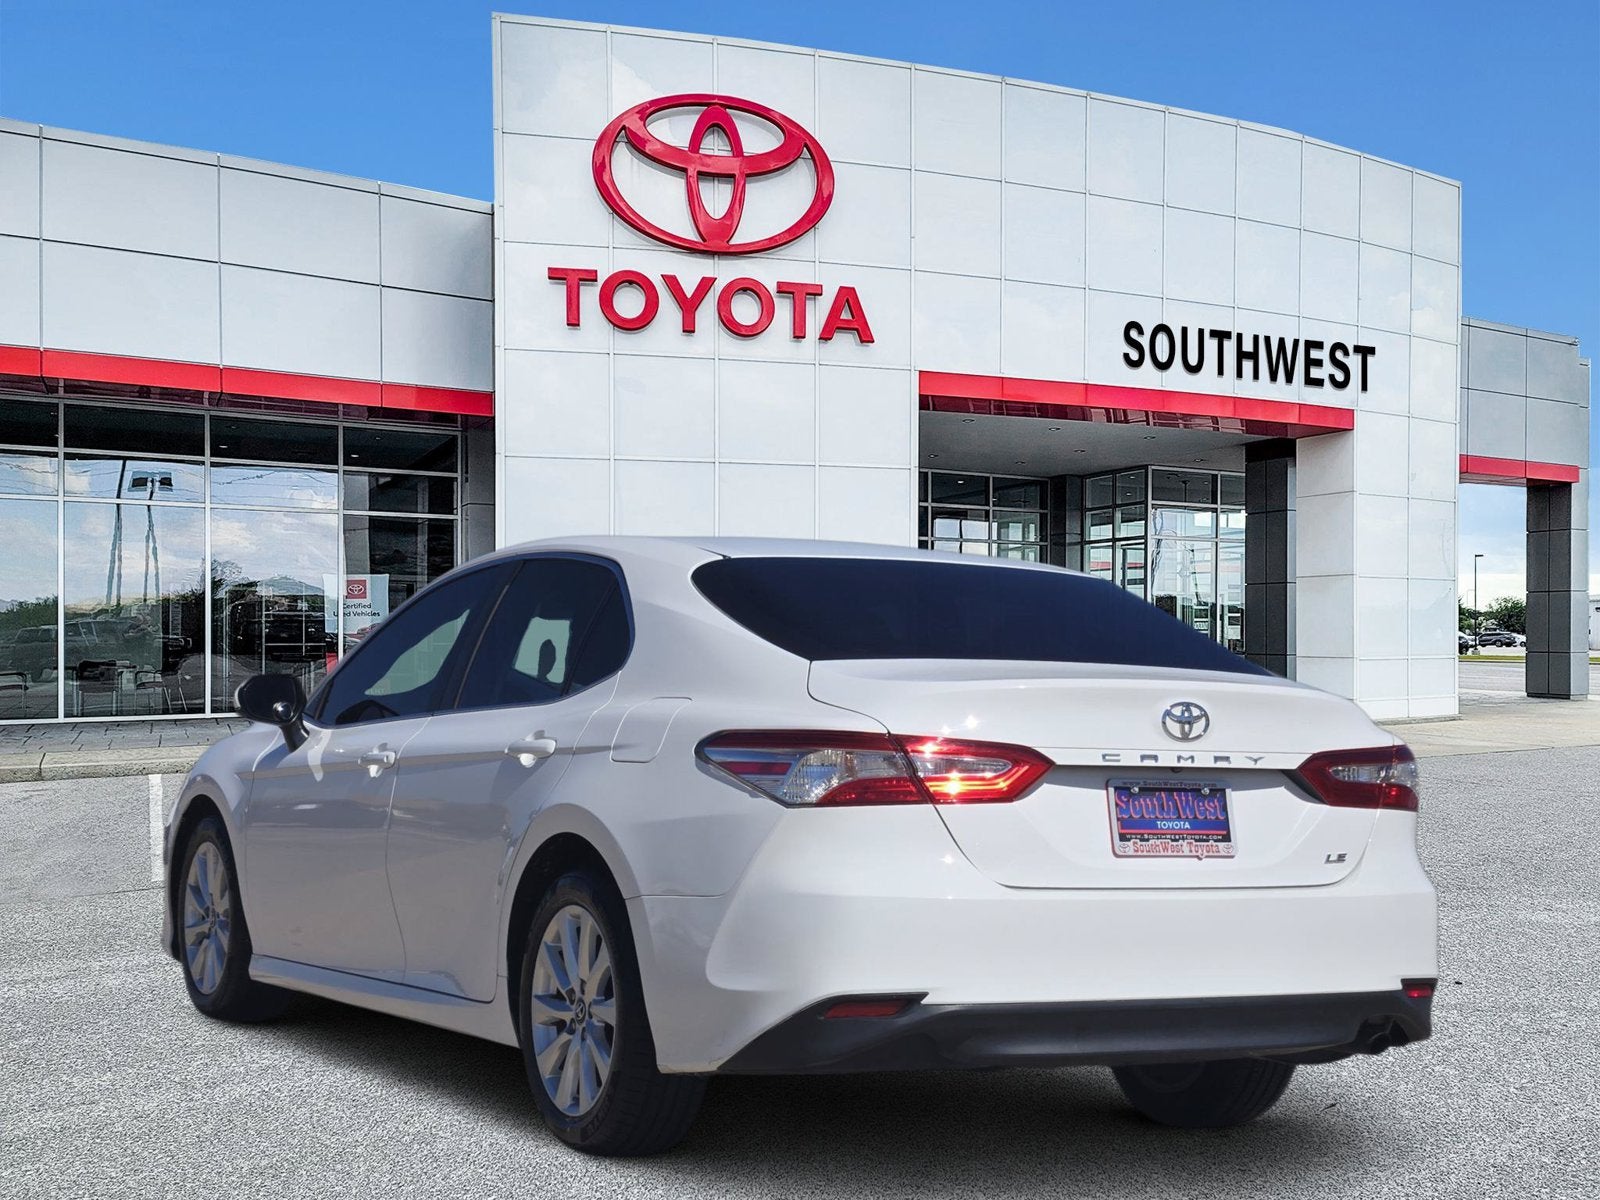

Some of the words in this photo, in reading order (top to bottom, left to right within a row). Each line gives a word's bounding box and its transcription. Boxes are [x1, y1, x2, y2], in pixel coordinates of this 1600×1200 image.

[548, 267, 875, 343] TOYOTA
[1123, 320, 1376, 392] SOUTHWEST
[1101, 753, 1265, 765] CAMRY
[1115, 787, 1225, 819] SouthWest
[1156, 821, 1191, 829] TOYOTA
[1132, 840, 1184, 854] SouthWest
[1186, 841, 1220, 857] Toyota
[1324, 853, 1347, 864] LE
